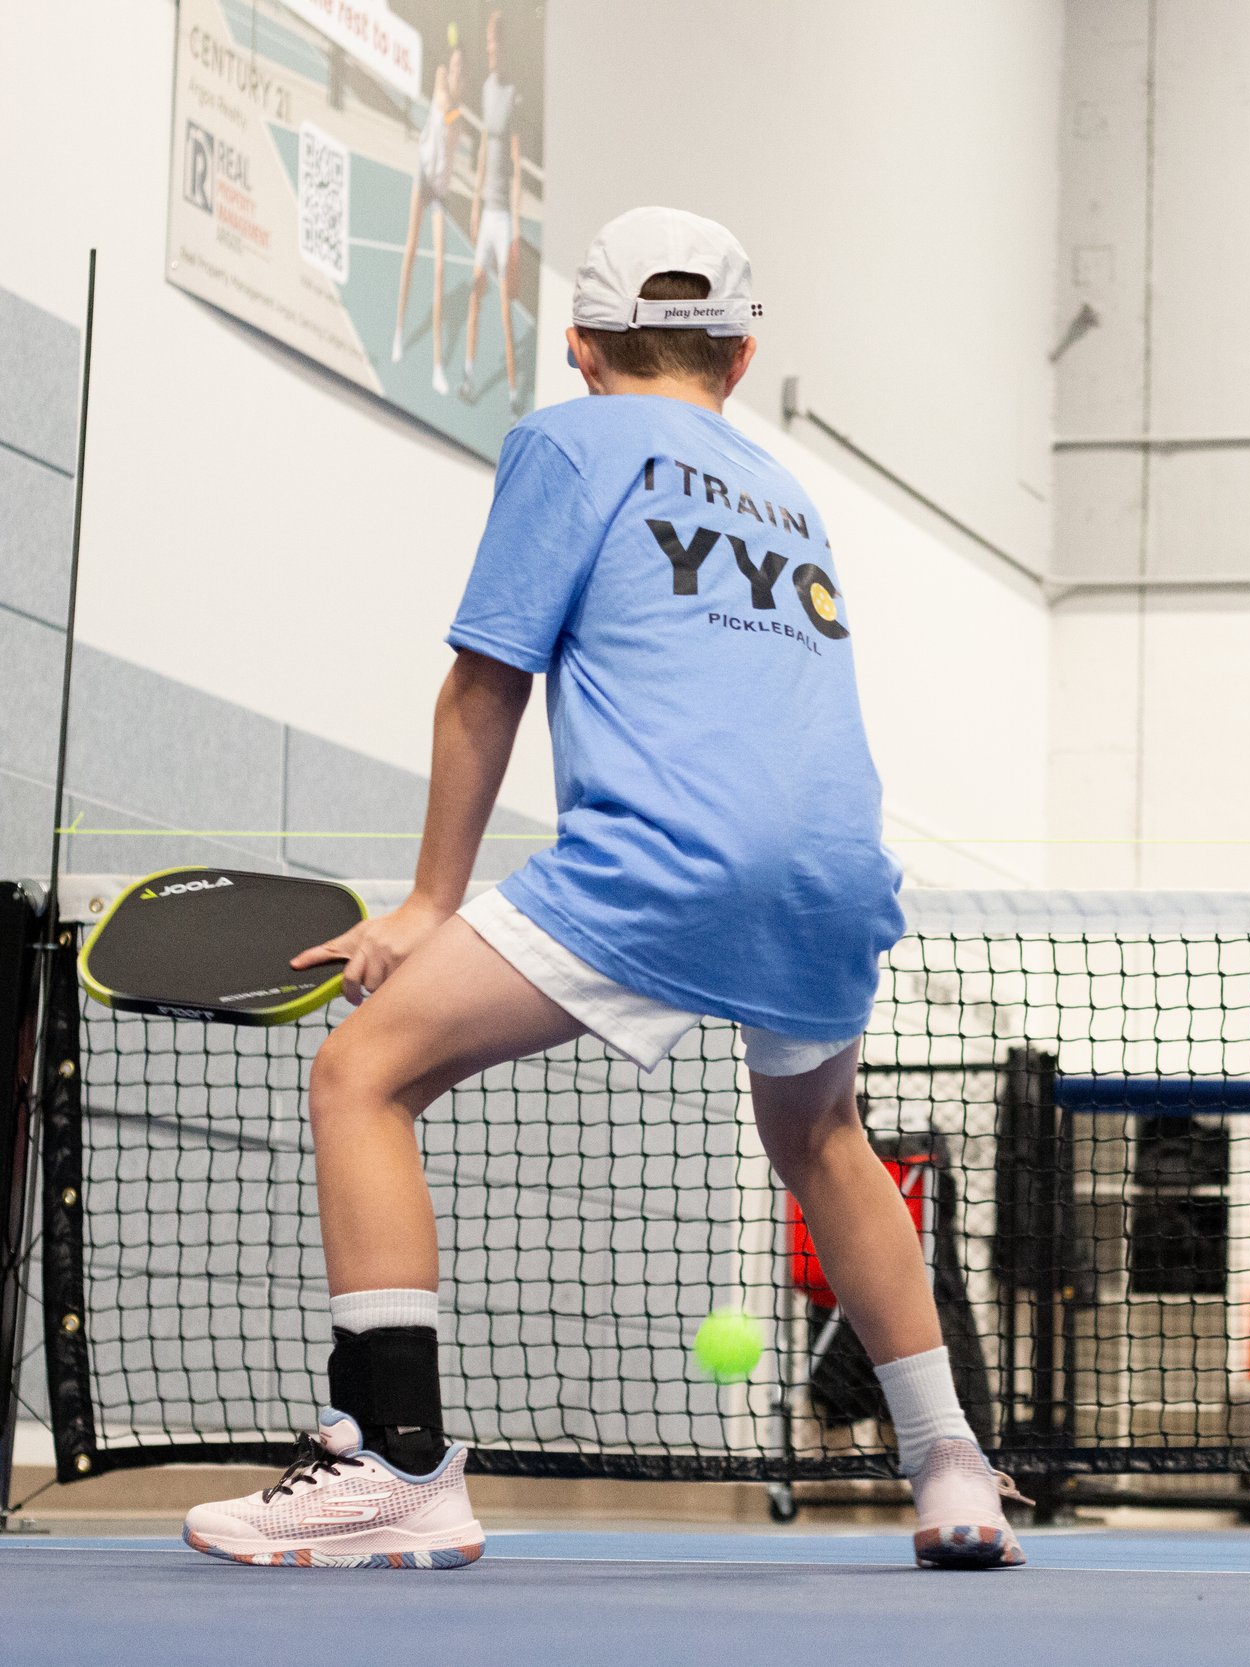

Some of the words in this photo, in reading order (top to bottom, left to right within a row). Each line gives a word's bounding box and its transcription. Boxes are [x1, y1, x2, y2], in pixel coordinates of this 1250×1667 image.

[373, 20, 390, 56] to
[188, 25, 272, 109] CENTURY
[275, 85, 291, 124] 21
[217, 140, 252, 192] REAL
[664, 307, 691, 319] play
[693, 307, 725, 316] better
[644, 457, 655, 491] I
[674, 459, 810, 541] TRAIN
[644, 518, 851, 640] YYC
[708, 612, 822, 657] PICKLEBALL
[159, 876, 234, 897] JOOLA
